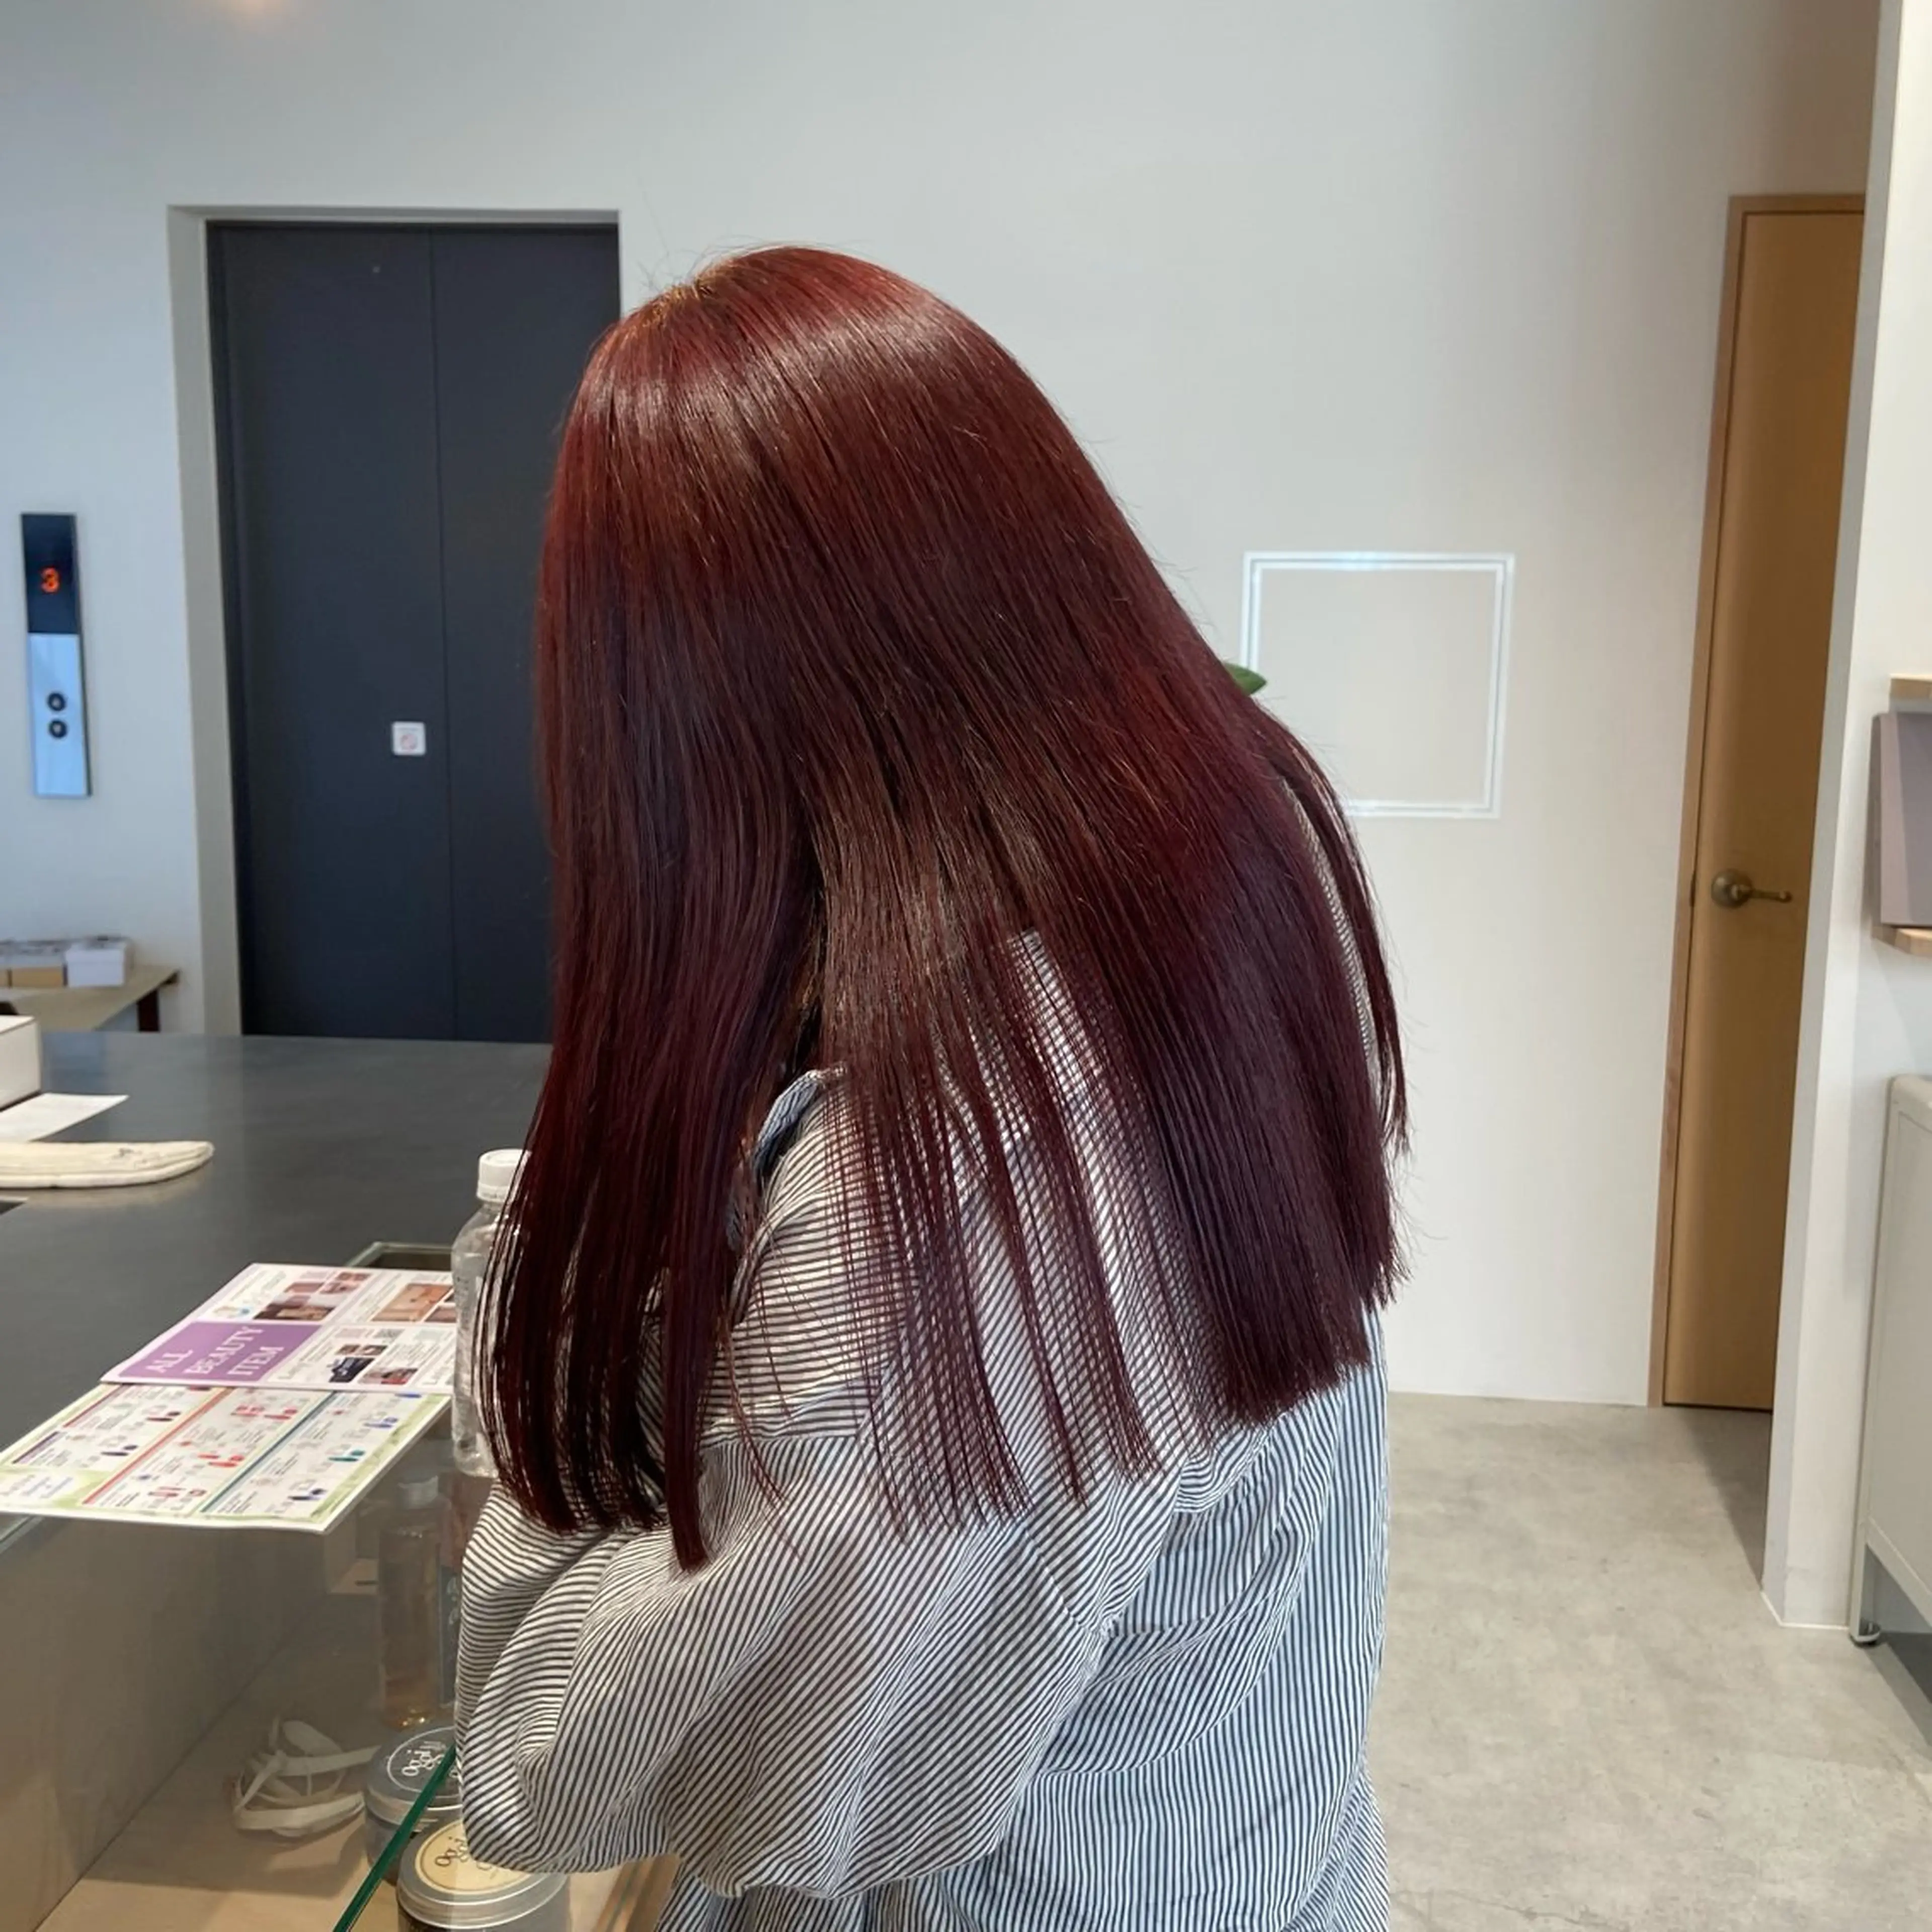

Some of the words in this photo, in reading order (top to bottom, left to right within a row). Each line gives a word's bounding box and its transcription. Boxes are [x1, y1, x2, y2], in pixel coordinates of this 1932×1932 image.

[41, 568, 60, 593] 3
[146, 1348, 194, 1373] ALL
[183, 1326, 264, 1375] BEAUTY
[227, 1346, 285, 1376] ITEM
